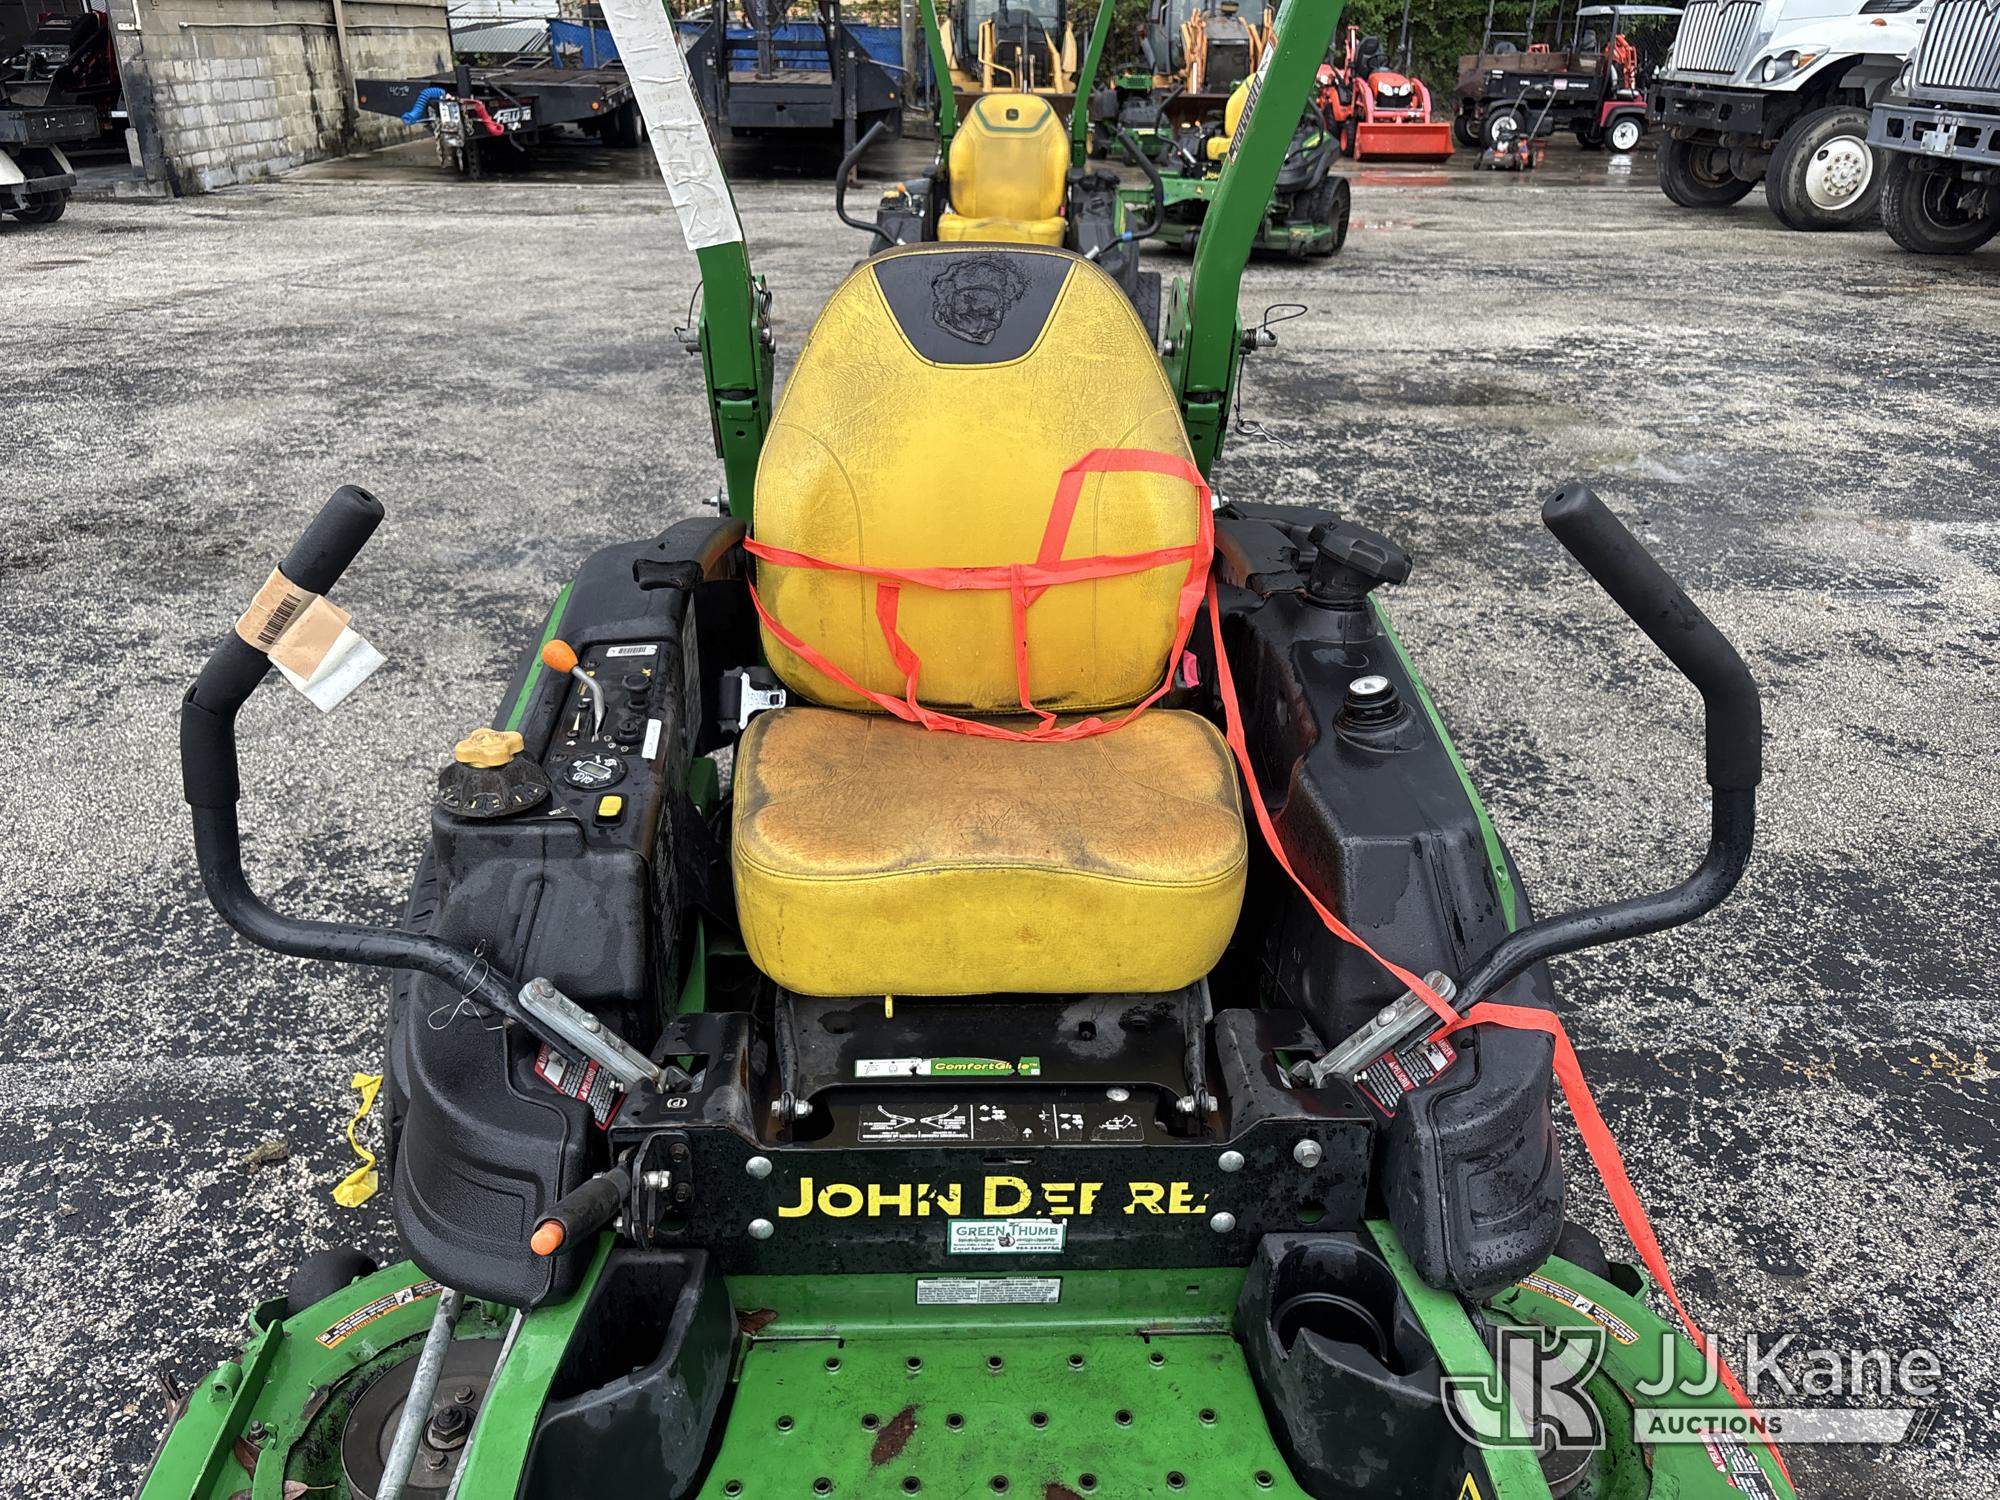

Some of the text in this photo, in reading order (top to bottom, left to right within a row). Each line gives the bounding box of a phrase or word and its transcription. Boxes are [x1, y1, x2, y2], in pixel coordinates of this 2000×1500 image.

[777, 1176, 962, 1218] JOHN
[956, 1222, 1058, 1236] GREEN THUMB
